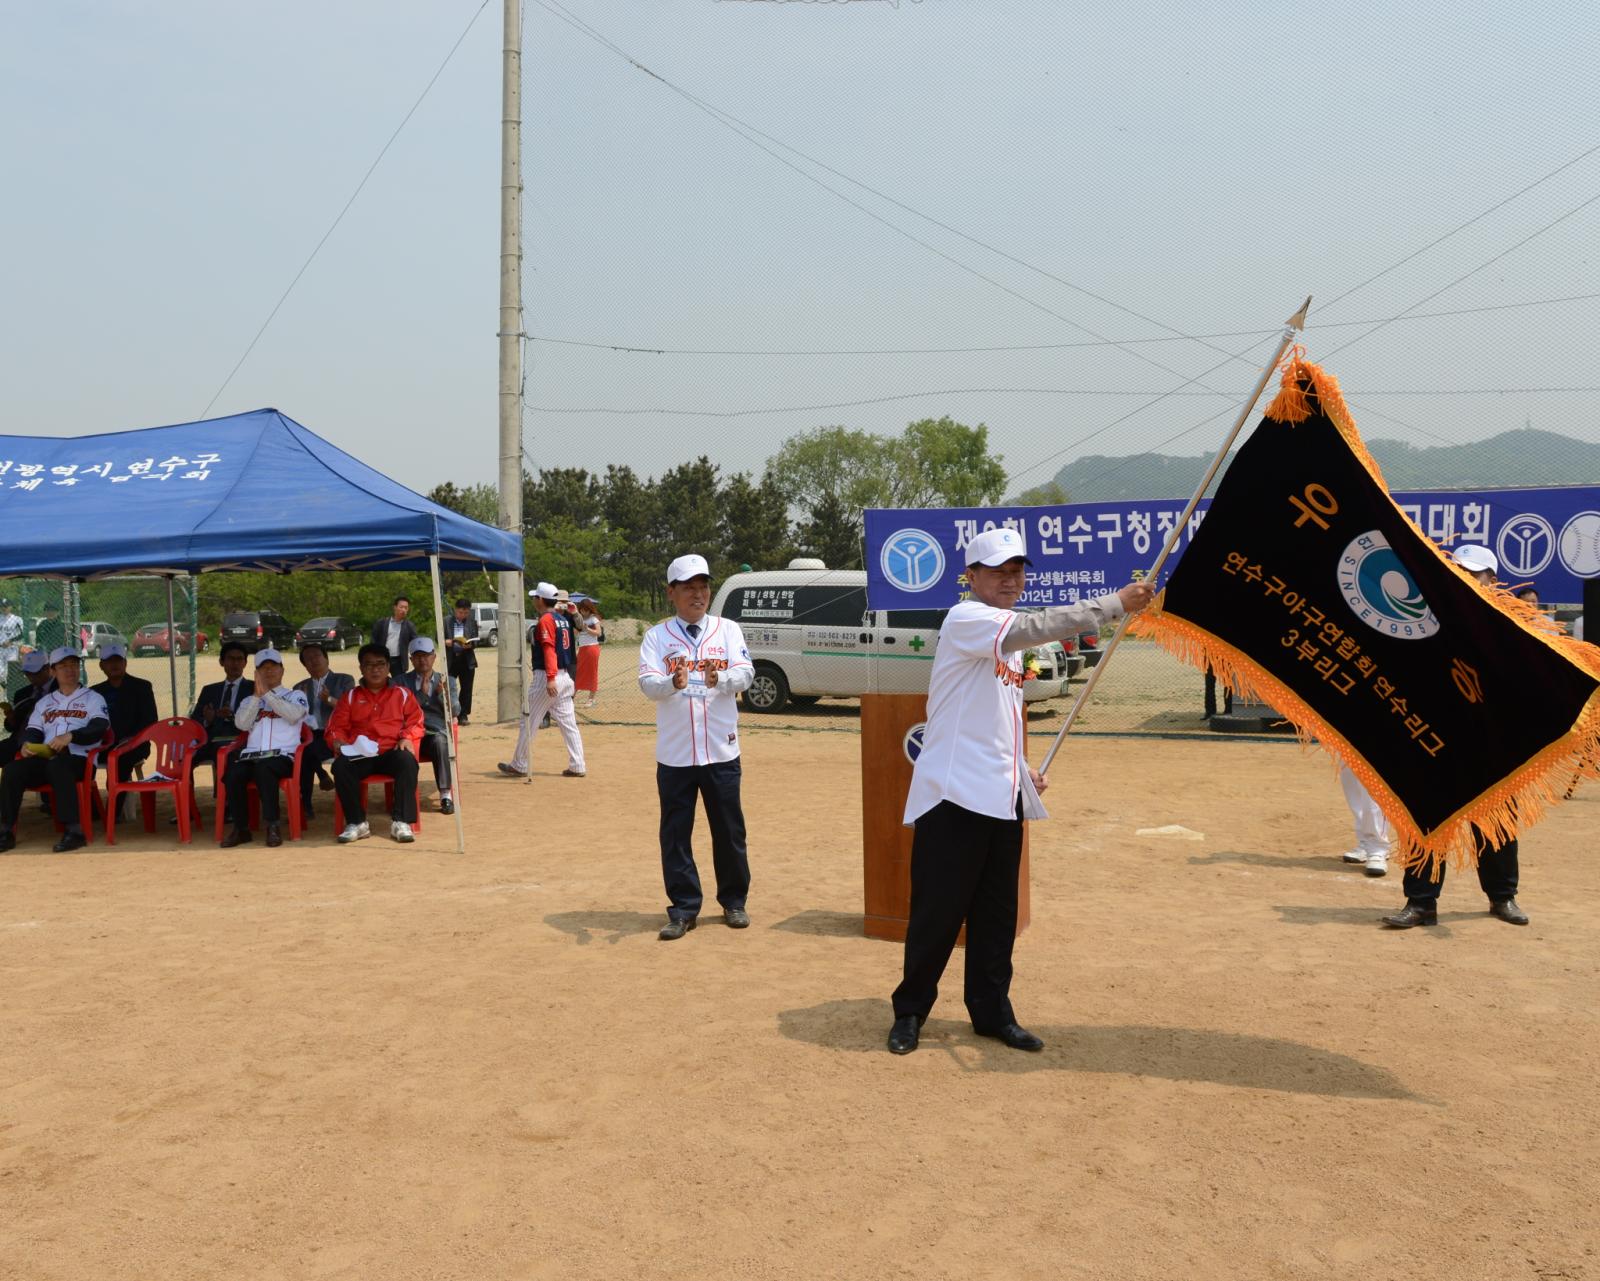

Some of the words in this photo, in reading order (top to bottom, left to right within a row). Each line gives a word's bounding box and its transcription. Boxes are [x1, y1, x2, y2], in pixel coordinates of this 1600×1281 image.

[128, 453, 221, 475] 연수구
[1288, 482, 1339, 530] 우
[1016, 589, 1053, 603] 012년
[1341, 556, 1372, 619] SINCE
[1375, 619, 1426, 636] 1995
[1222, 551, 1377, 678] 연수구야구연합회
[1373, 675, 1445, 757] 연수리그
